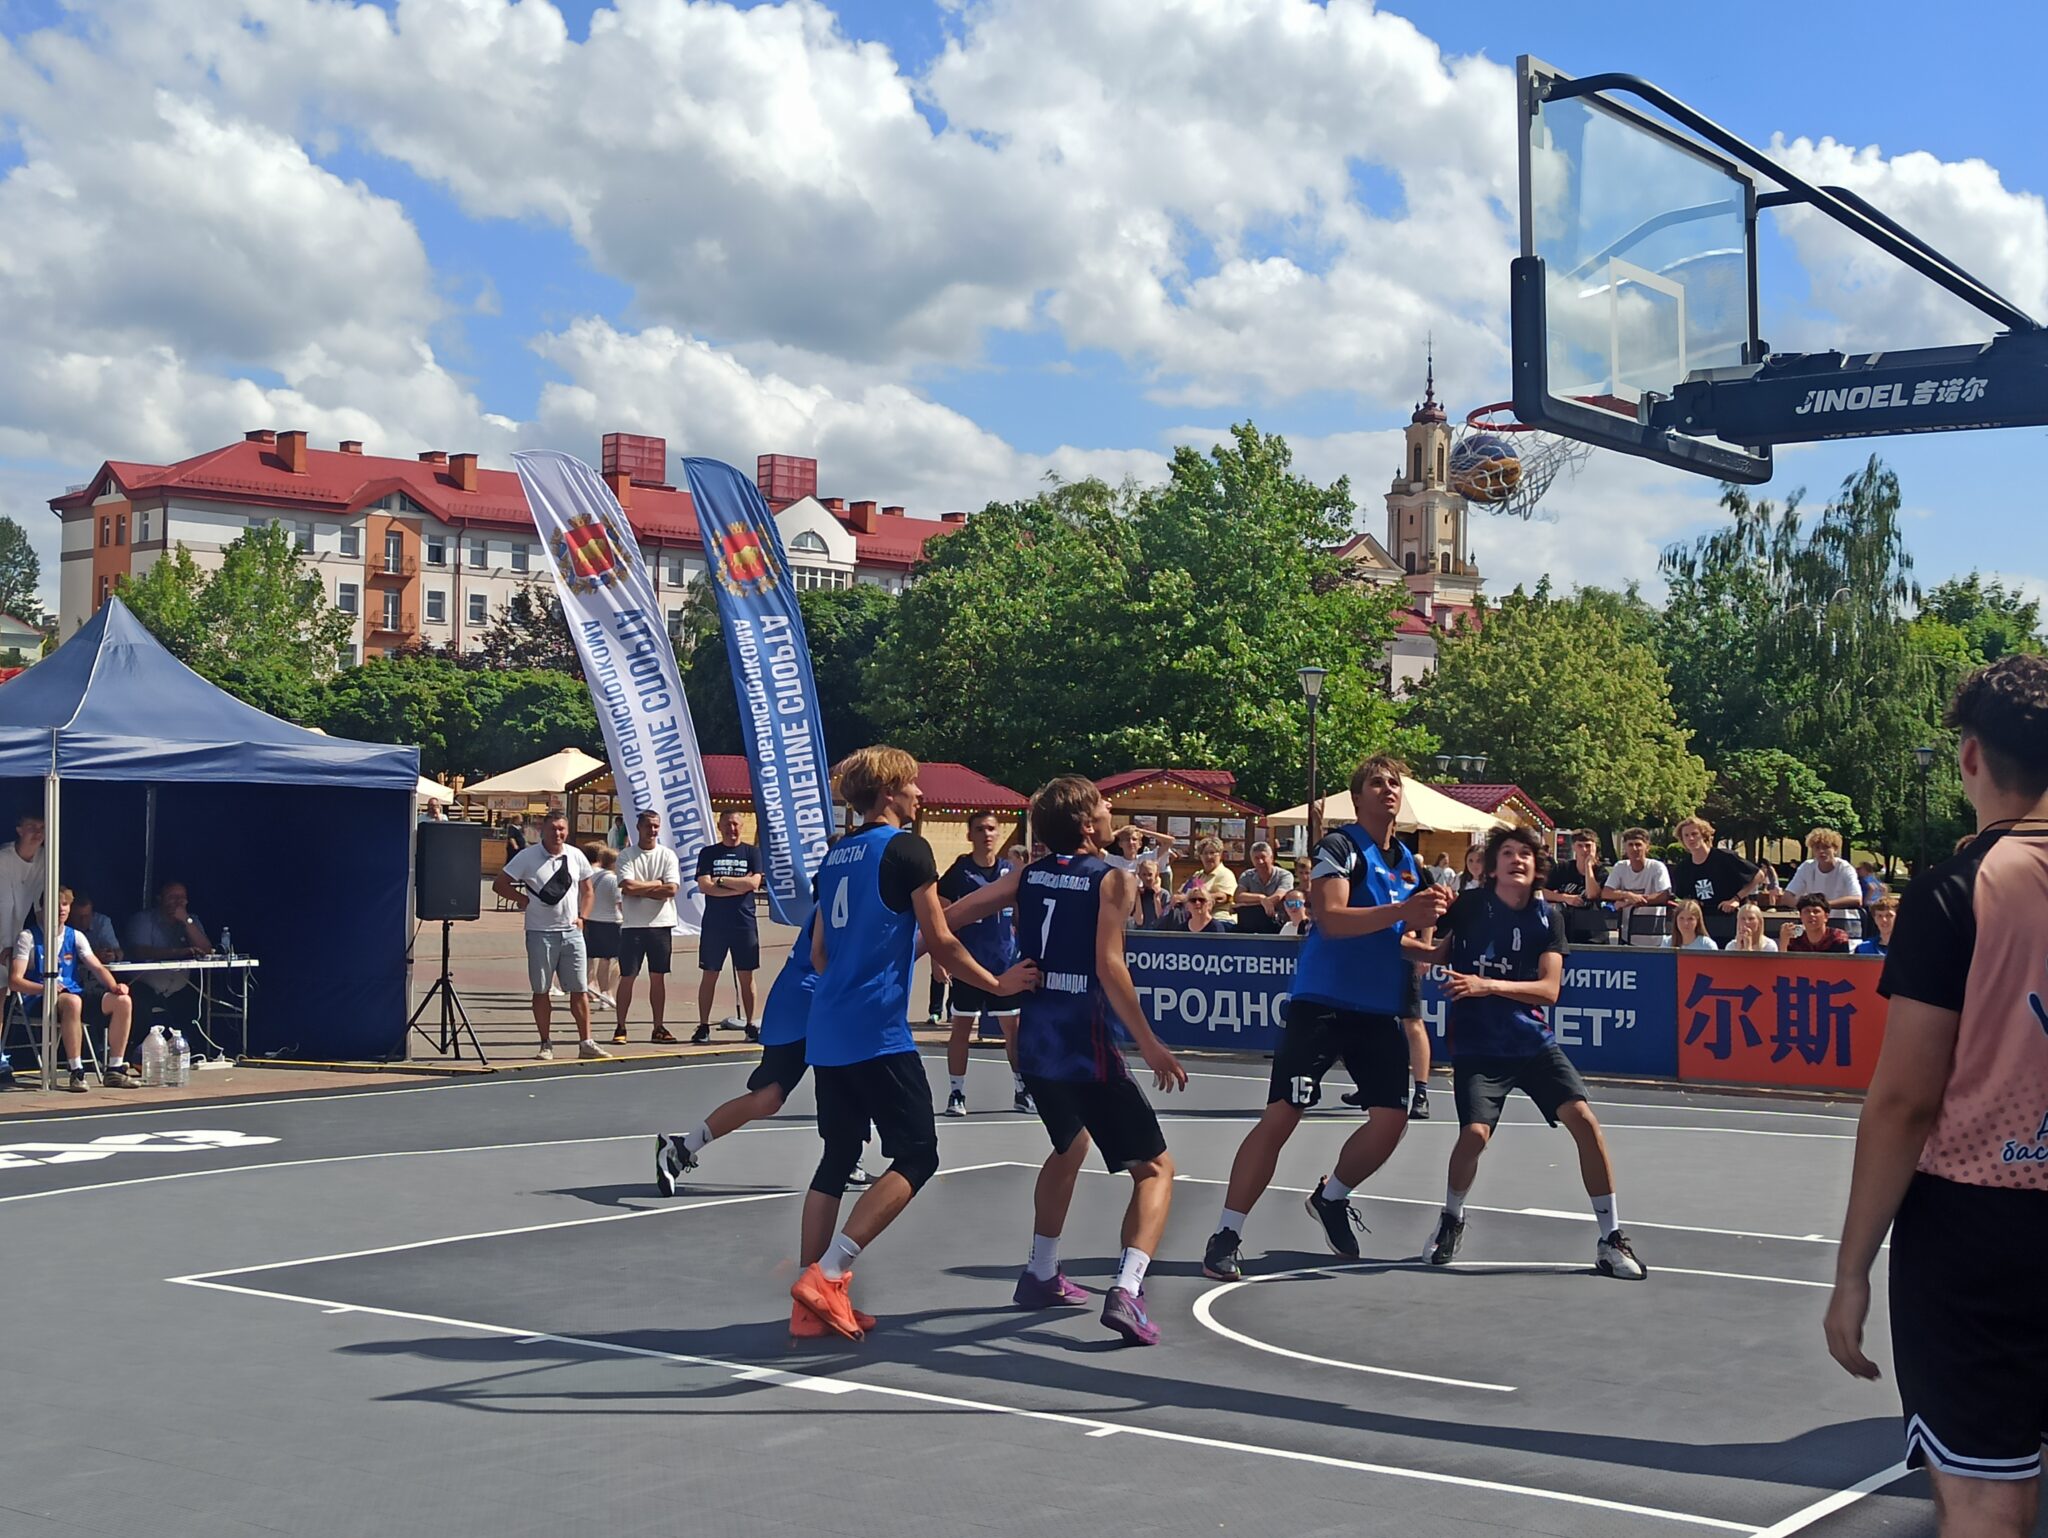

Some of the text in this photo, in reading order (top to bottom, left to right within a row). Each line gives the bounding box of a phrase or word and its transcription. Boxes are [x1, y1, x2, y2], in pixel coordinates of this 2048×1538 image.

[1795, 377, 1988, 414] JINOEL 吉诺尔
[826, 844, 867, 866] МОСТЫ
[1040, 898, 1056, 959] 7
[1512, 927, 1521, 951] 8
[1126, 952, 1637, 990] РОИЗВОДСТВЕНН ИЯТИЕ
[1684, 973, 1858, 1067] 尔斯
[1291, 1076, 1313, 1104] 15
[2002, 1140, 2048, 1162] бас
